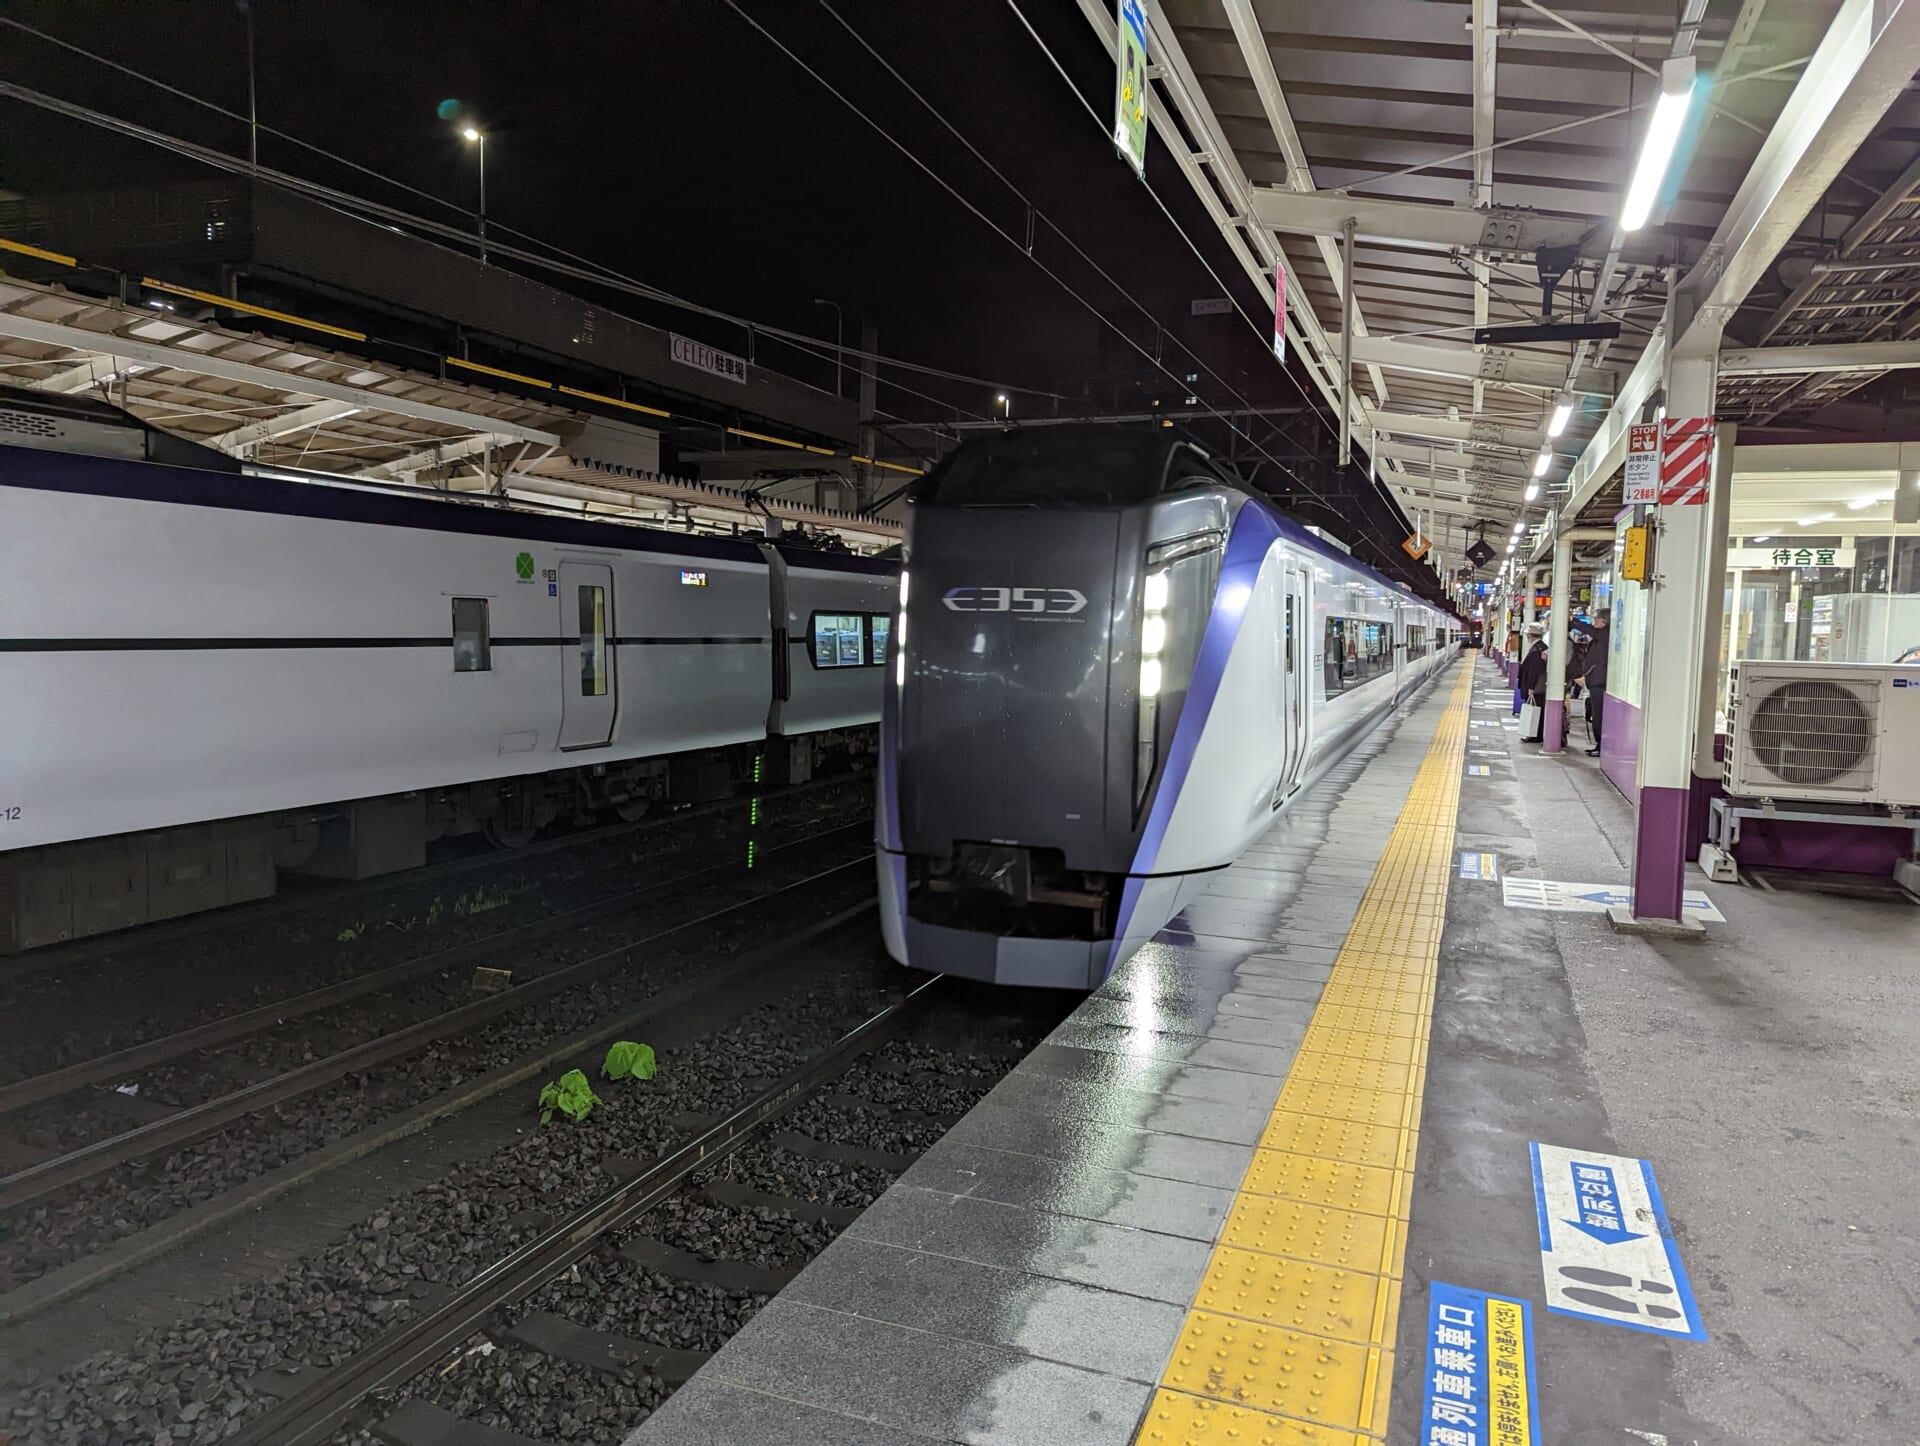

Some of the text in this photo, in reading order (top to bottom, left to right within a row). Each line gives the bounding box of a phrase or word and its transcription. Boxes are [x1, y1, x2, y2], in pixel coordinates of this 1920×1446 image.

[673, 338, 714, 370] CELEO
[1632, 426, 1657, 436] STOP
[1628, 454, 1657, 462] 非常停止
[1628, 463, 1649, 471] ボタン
[1772, 548, 1836, 566] 待合室
[942, 587, 1089, 614] E353
[1576, 1166, 1621, 1231] 整列位置
